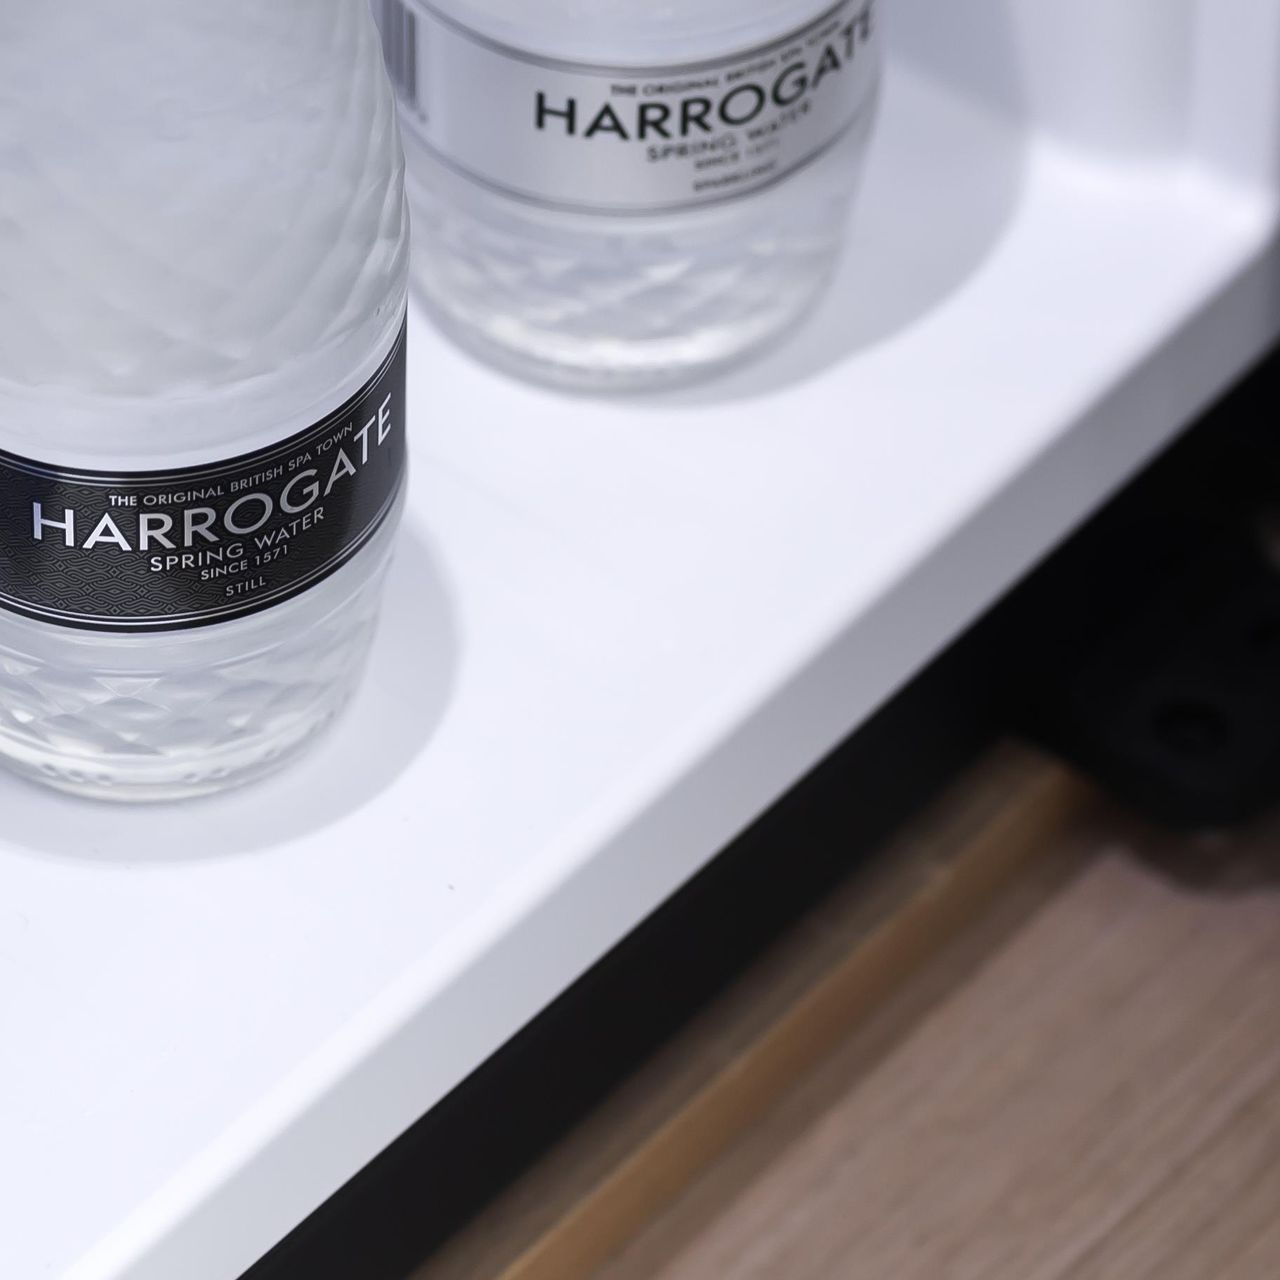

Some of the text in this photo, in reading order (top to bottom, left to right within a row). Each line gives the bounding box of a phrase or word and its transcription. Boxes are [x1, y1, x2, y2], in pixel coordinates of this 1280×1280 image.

[32, 392, 392, 552] HARROGATE
[109, 422, 354, 507] THE ORIGINAL BRITISH SPA TOWN
[150, 506, 325, 572] SPRING WATER
[200, 544, 289, 580] SINCE 1571
[225, 575, 267, 597] STILL
